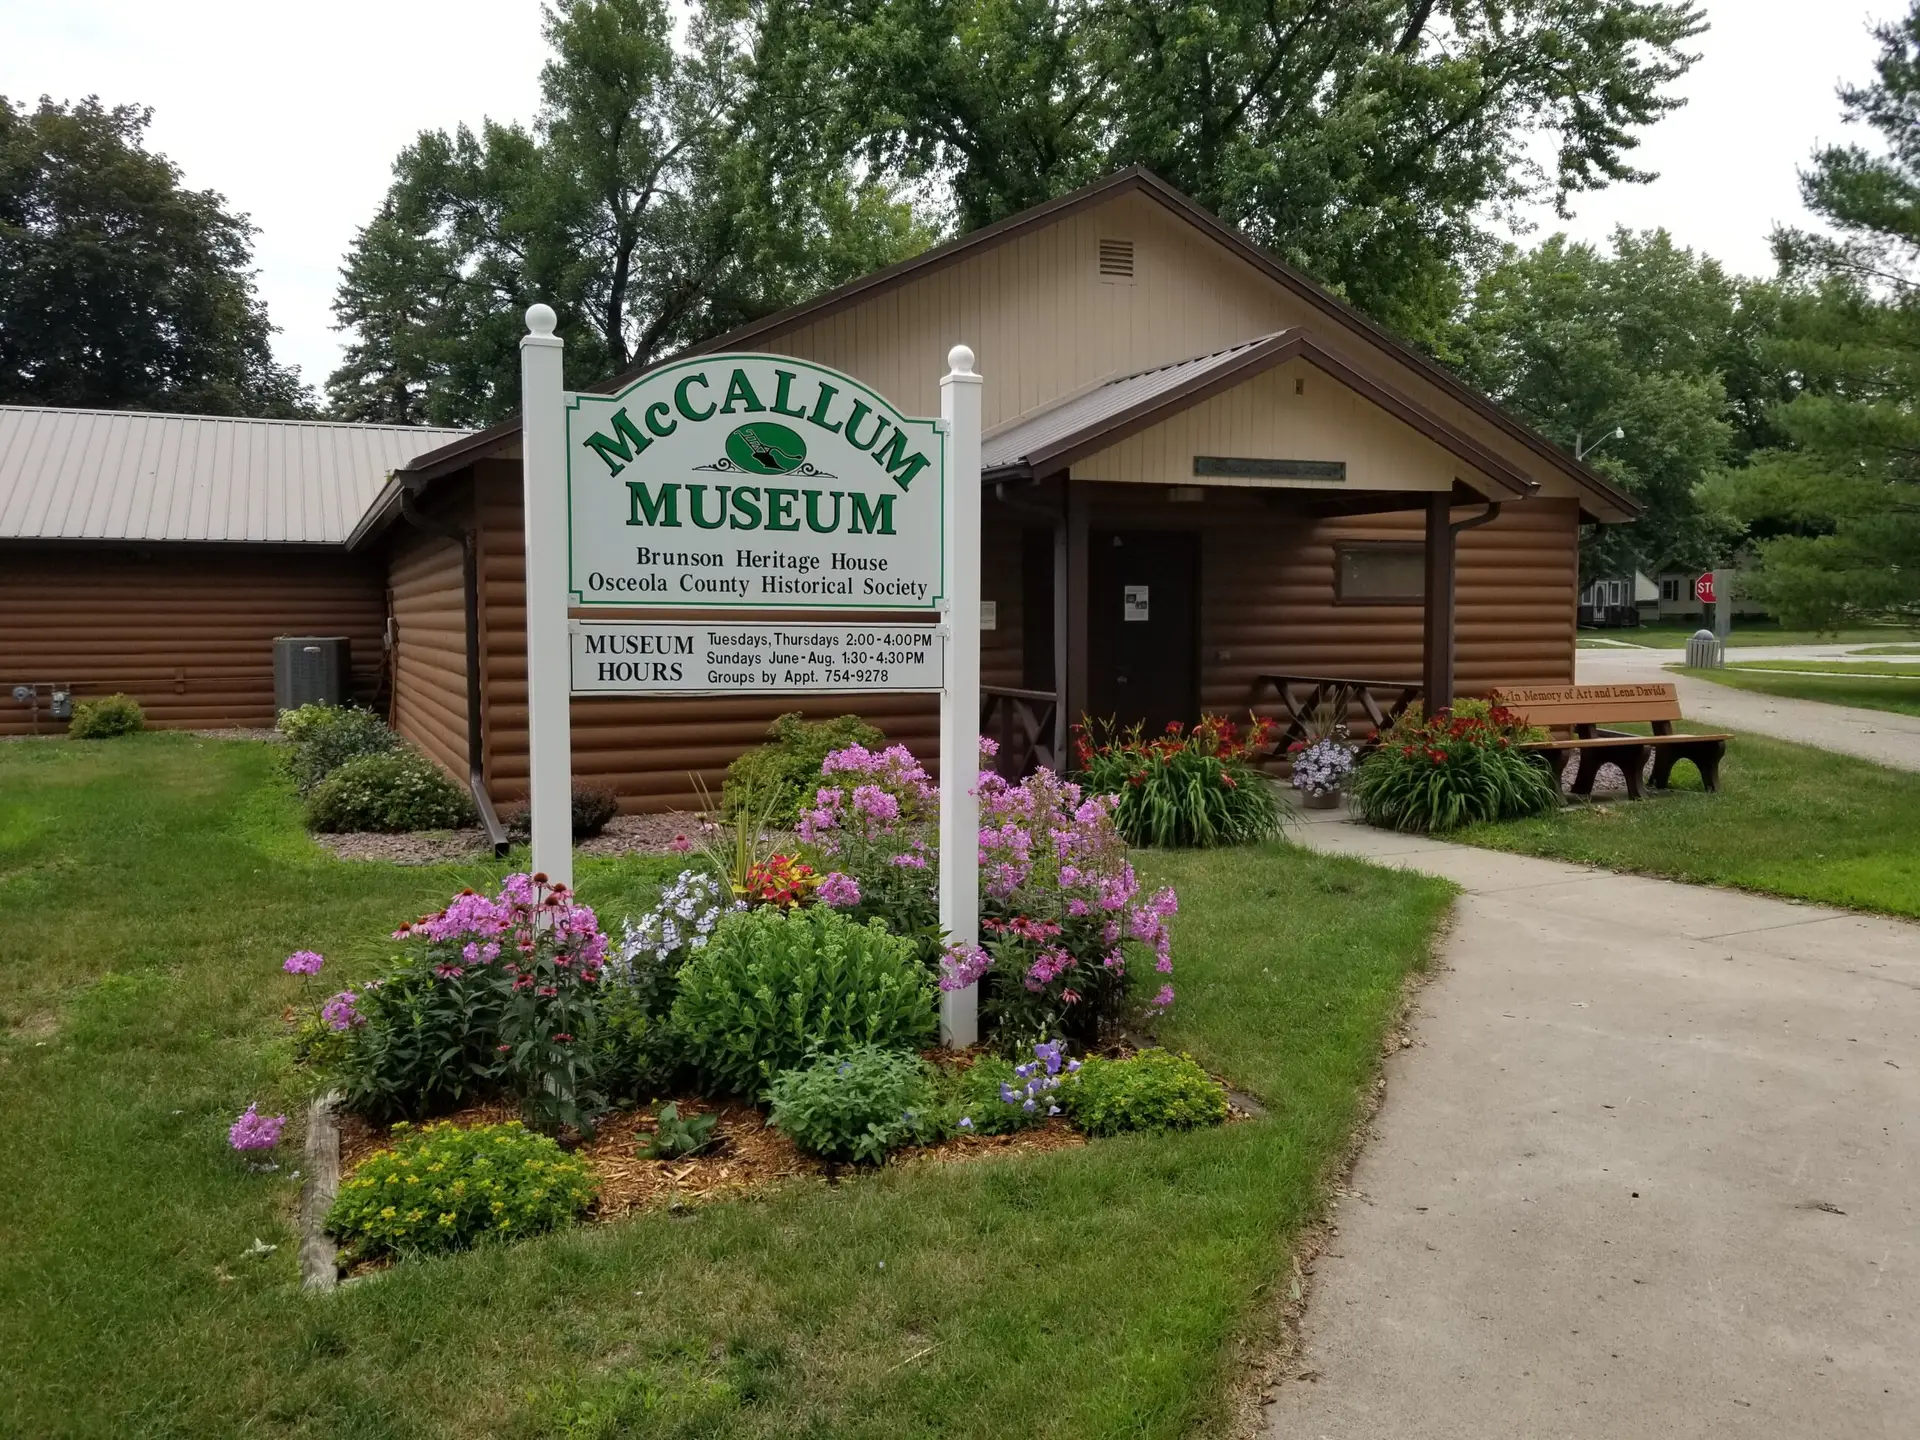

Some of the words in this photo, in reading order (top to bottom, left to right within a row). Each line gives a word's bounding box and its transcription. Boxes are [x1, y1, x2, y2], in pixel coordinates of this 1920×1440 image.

[583, 369, 931, 492] McCALLUM
[625, 481, 897, 535] MUSEUM
[636, 547, 724, 567] Brunson
[736, 550, 820, 574] Heritage
[831, 553, 888, 571] House
[588, 572, 668, 591] Osceola
[680, 574, 750, 597] County
[761, 576, 853, 594] Historical
[863, 578, 928, 600] Society
[585, 635, 694, 654] MUSEUM
[706, 651, 762, 667] Sundays
[598, 662, 683, 681] HOURS
[707, 670, 755, 686] Groups
[762, 671, 777, 685] by
[784, 670, 819, 685] Appt.
[825, 670, 889, 682] 754-9278
[1523, 690, 1561, 702] Memory
[1564, 689, 1573, 699] of
[1576, 688, 1592, 699] Art
[1595, 687, 1611, 698] and
[1612, 687, 1635, 697] Lena
[1636, 685, 1666, 696] Davids
